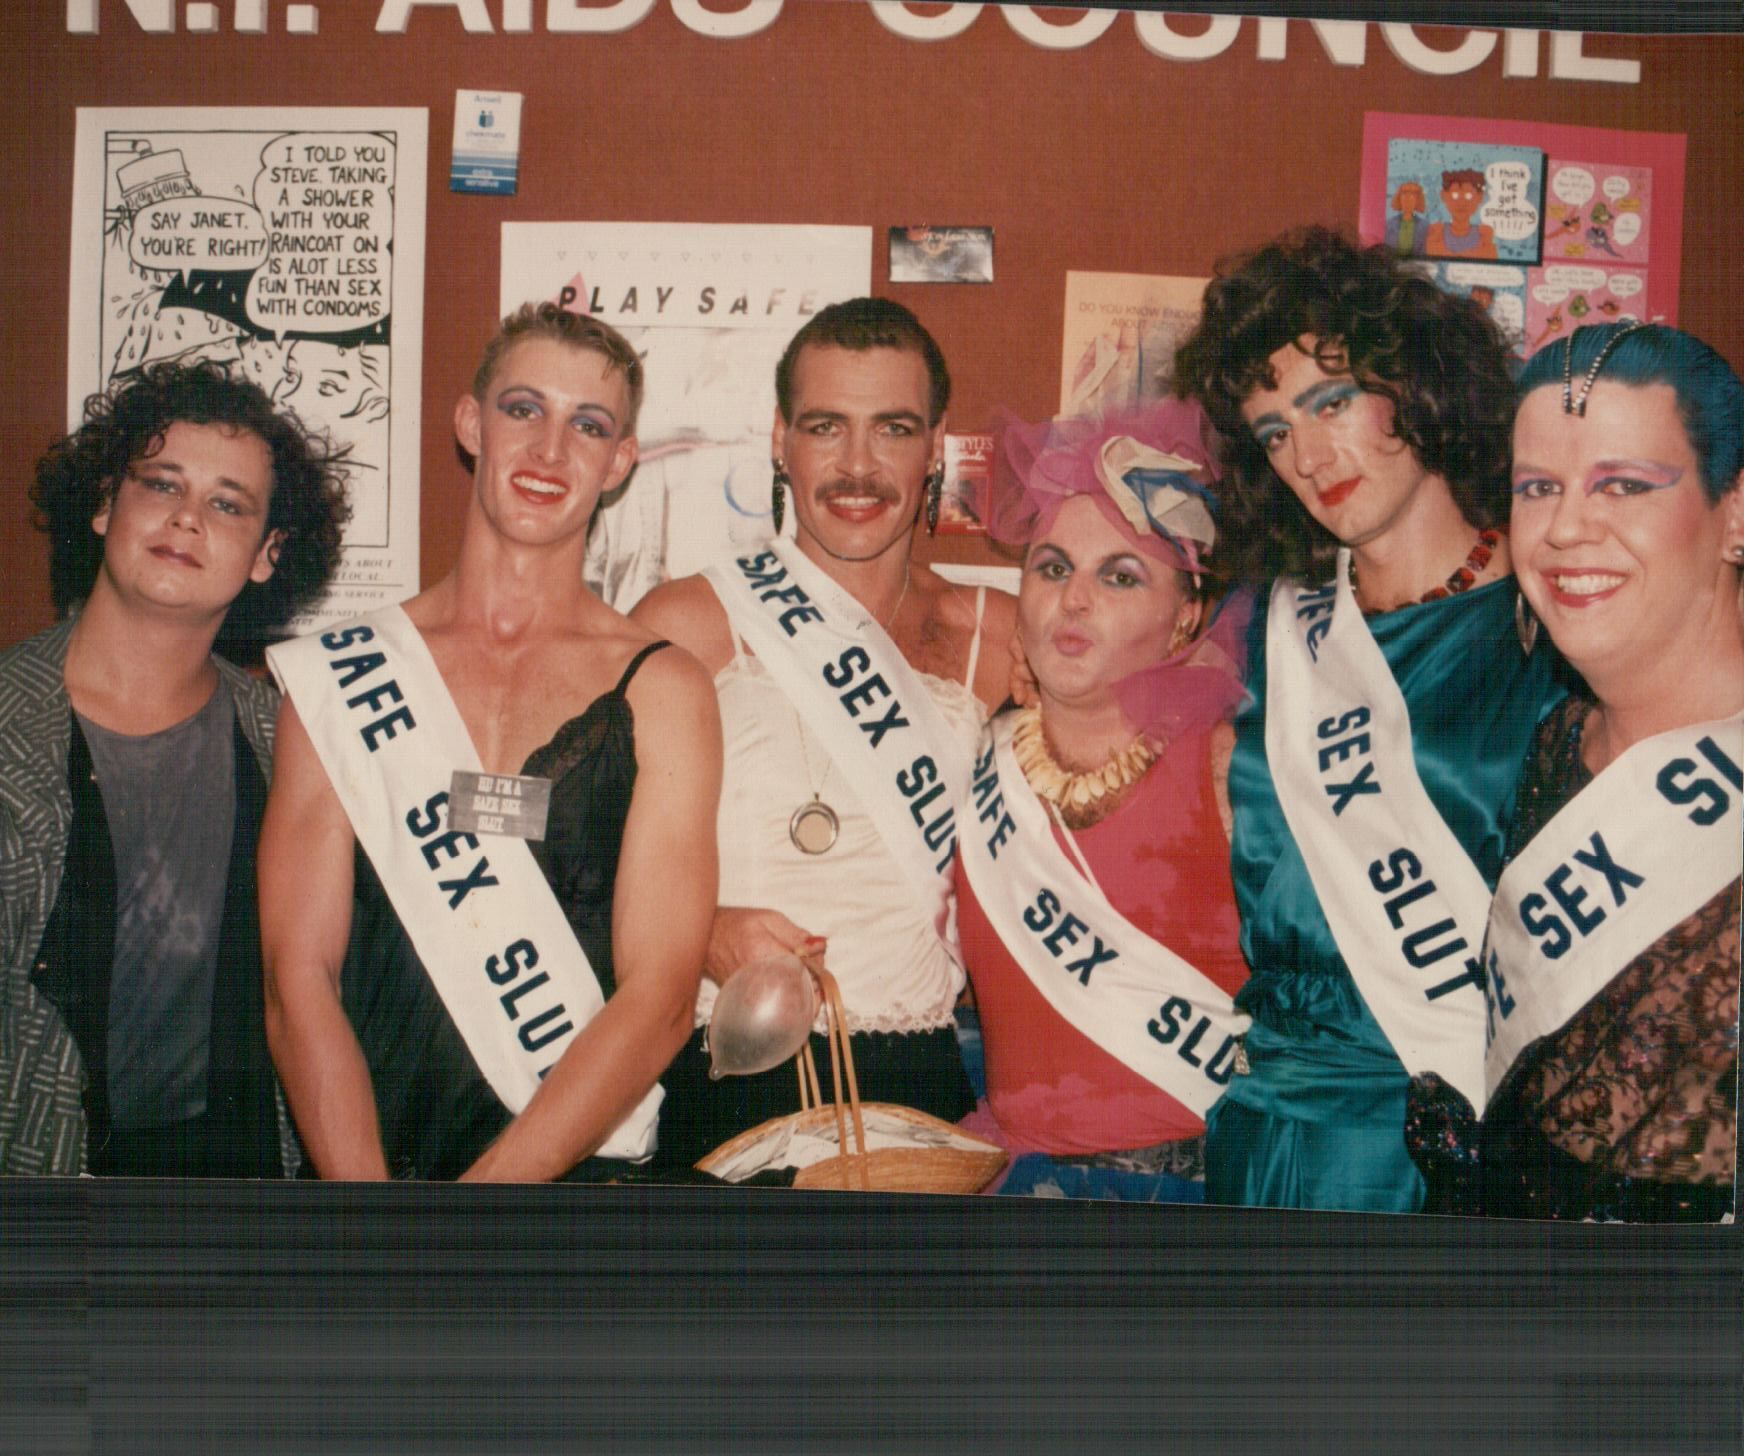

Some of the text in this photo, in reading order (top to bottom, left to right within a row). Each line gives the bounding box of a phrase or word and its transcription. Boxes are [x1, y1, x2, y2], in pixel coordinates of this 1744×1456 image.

[286, 146, 386, 163] I TOLD YOU
[328, 166, 388, 184] TAKING
[1499, 168, 1526, 178] think
[278, 187, 374, 208] A SHOWER
[1498, 194, 1517, 208] got
[151, 212, 181, 230] SAY
[271, 211, 370, 230] WITH YOUR
[1484, 207, 1537, 224] something
[141, 236, 267, 257] YOU'RE RIGHT!
[271, 232, 379, 253] RAINCOAT ON
[268, 257, 377, 275] IS ALOT LESS
[258, 276, 382, 297] FUN THAN SEX
[256, 298, 297, 315] WITH
[558, 286, 820, 315] PLAY SAFE
[1100, 303, 1122, 314] YOU
[736, 551, 825, 637] SAFE
[822, 646, 910, 749] SEX
[320, 626, 574, 1080] SAFE SEX SLU
[1317, 706, 1382, 817] SEX
[1368, 847, 1487, 1001] SLUT
[1520, 830, 1646, 960] SEX
[1023, 888, 1120, 987] SEX
[1147, 995, 1236, 1085] SLU
